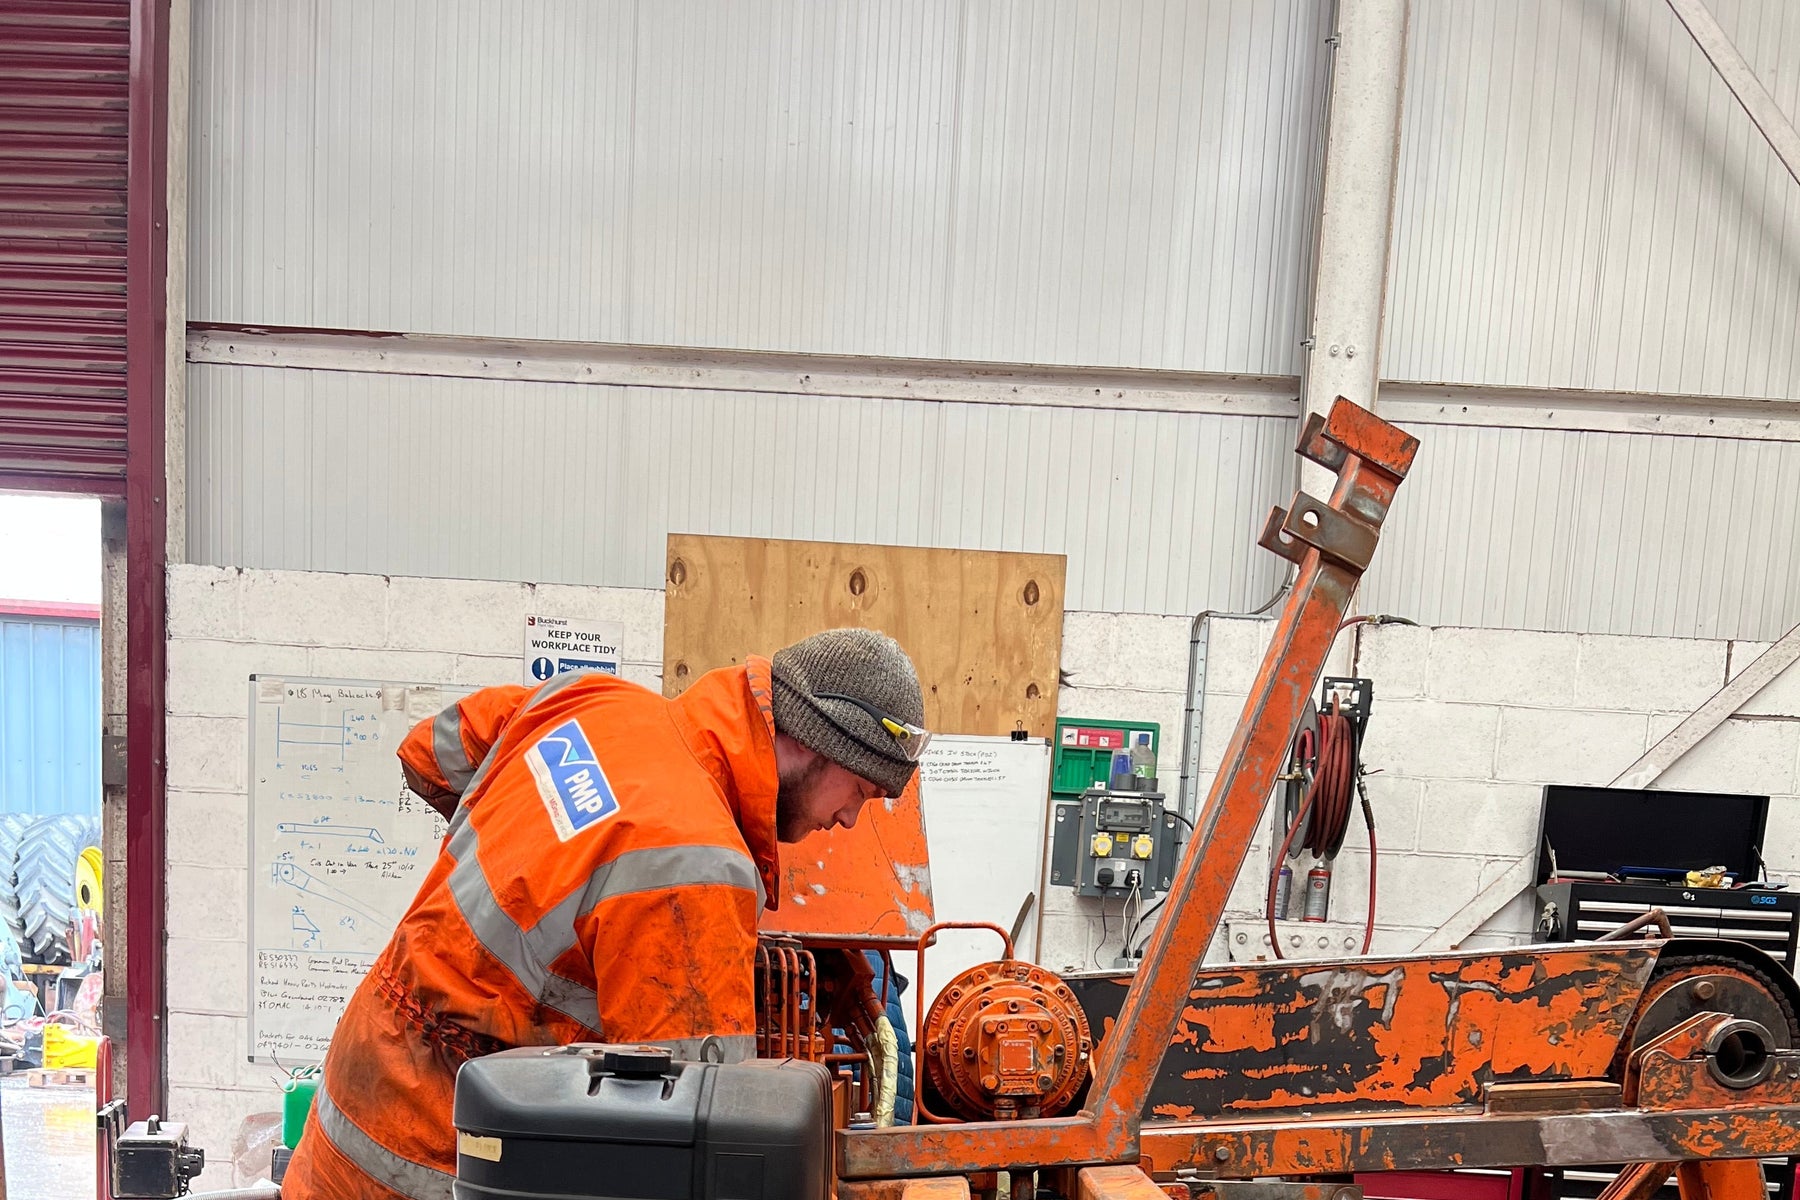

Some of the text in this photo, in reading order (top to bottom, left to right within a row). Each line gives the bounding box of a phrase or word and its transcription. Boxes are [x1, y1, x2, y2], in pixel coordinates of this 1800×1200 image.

[537, 617, 567, 626] Buckhurst
[548, 630, 601, 642] KEEP YOUR
[531, 640, 617, 655] WORKPLACE TIDY
[564, 768, 603, 814] PMP
